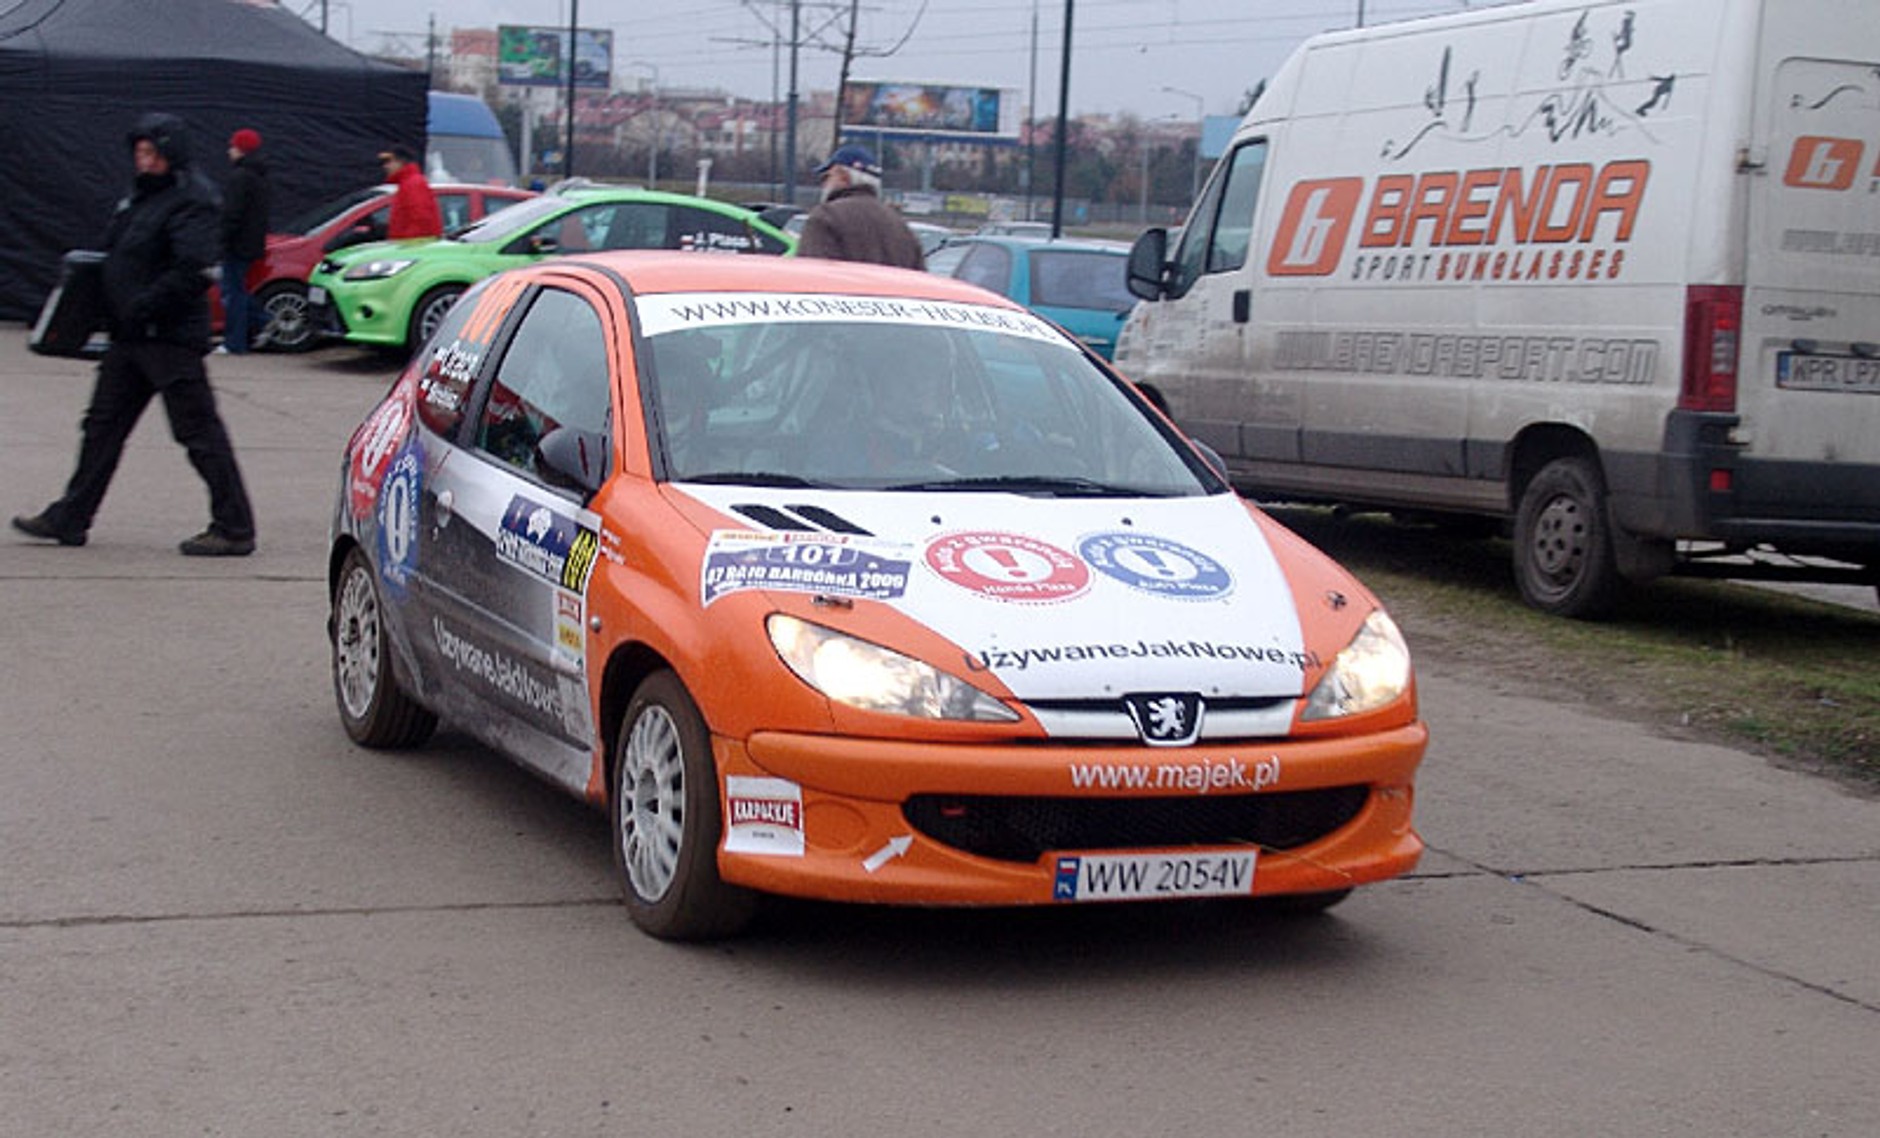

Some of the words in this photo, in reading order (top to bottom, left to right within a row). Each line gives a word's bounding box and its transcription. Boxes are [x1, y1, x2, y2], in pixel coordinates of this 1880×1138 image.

[1359, 160, 1651, 248] BRENDA
[1352, 254, 1431, 281] SPORT
[1436, 249, 1624, 281] SUNGLASSES
[782, 545, 844, 565] 101
[860, 571, 906, 590] 2009
[963, 640, 1323, 672] UżywaneJakNowe.pl
[1069, 755, 1281, 794] www.majek.pl
[1086, 859, 1149, 894] WW
[1155, 856, 1250, 892] 2054V
